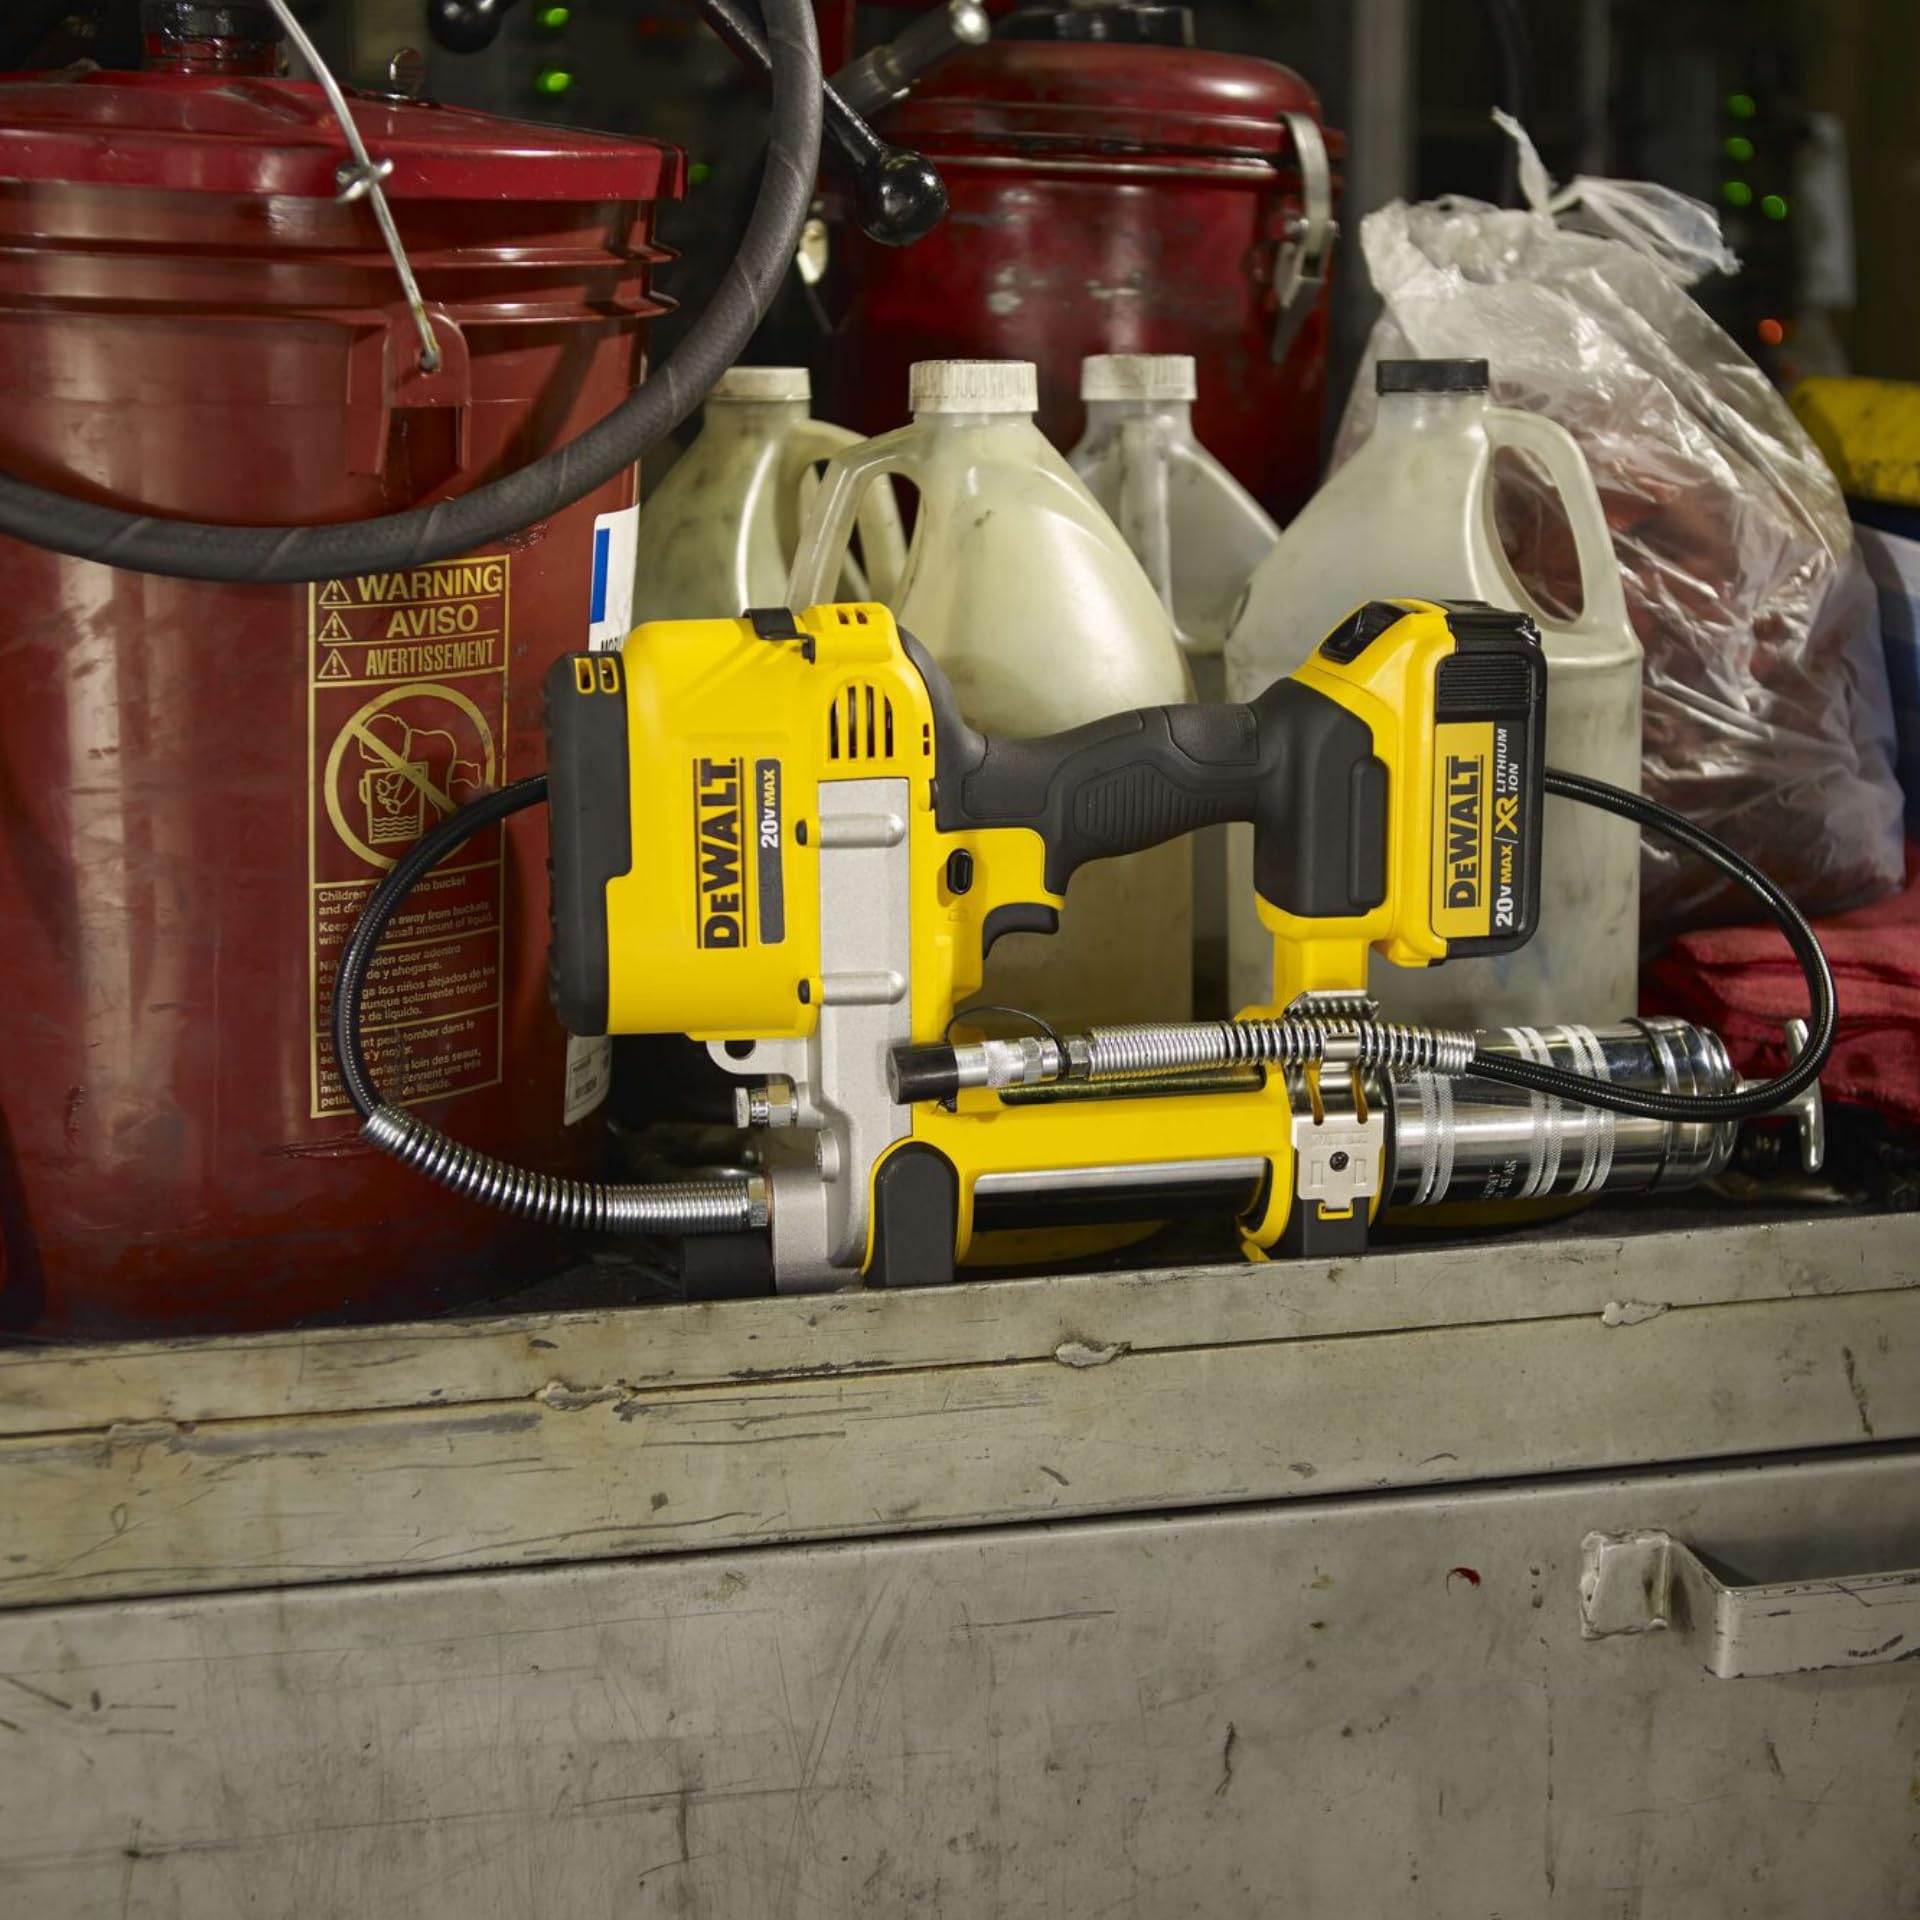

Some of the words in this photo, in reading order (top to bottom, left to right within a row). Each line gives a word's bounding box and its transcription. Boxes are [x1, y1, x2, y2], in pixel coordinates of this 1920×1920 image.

[357, 564, 503, 602] WARNING
[386, 603, 479, 638] AVISO
[365, 639, 496, 676] AVERTISSEMENT
[1497, 728, 1508, 793] LITHIUM
[1508, 763, 1520, 792] ION
[764, 769, 776, 807] MAX
[760, 808, 779, 849] 20V
[1449, 755, 1480, 909] DEWALT
[1495, 794, 1518, 835] XR
[1500, 844, 1513, 884] MAX
[318, 890, 367, 902] Children
[318, 903, 341, 915] and
[1495, 884, 1513, 928] 20V
[319, 922, 349, 935] Keep
[398, 913, 426, 926] away
[428, 908, 451, 920] from
[402, 1028, 440, 1041] tomber
